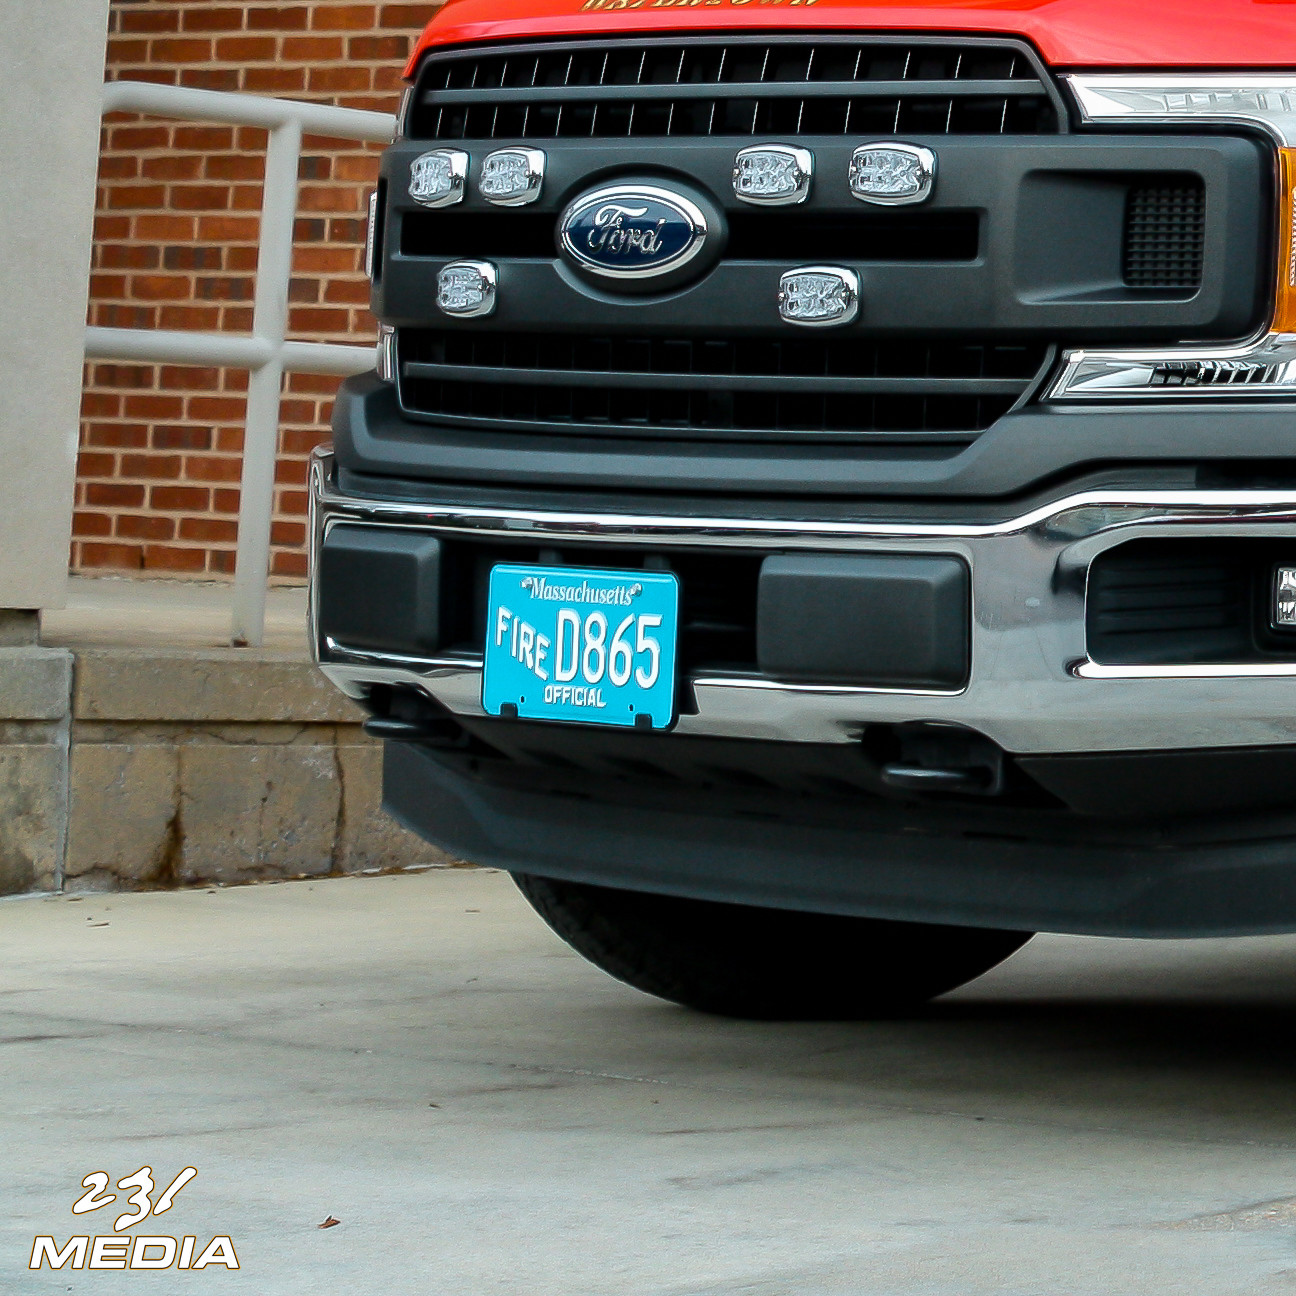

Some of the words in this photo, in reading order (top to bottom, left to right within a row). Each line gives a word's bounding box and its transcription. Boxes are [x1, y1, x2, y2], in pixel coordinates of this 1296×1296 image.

[588, 205, 665, 255] Ford
[531, 577, 633, 606] Massachusetts
[495, 605, 551, 681] FIRE
[555, 608, 663, 689] D865
[544, 685, 606, 707] OFFICIAL
